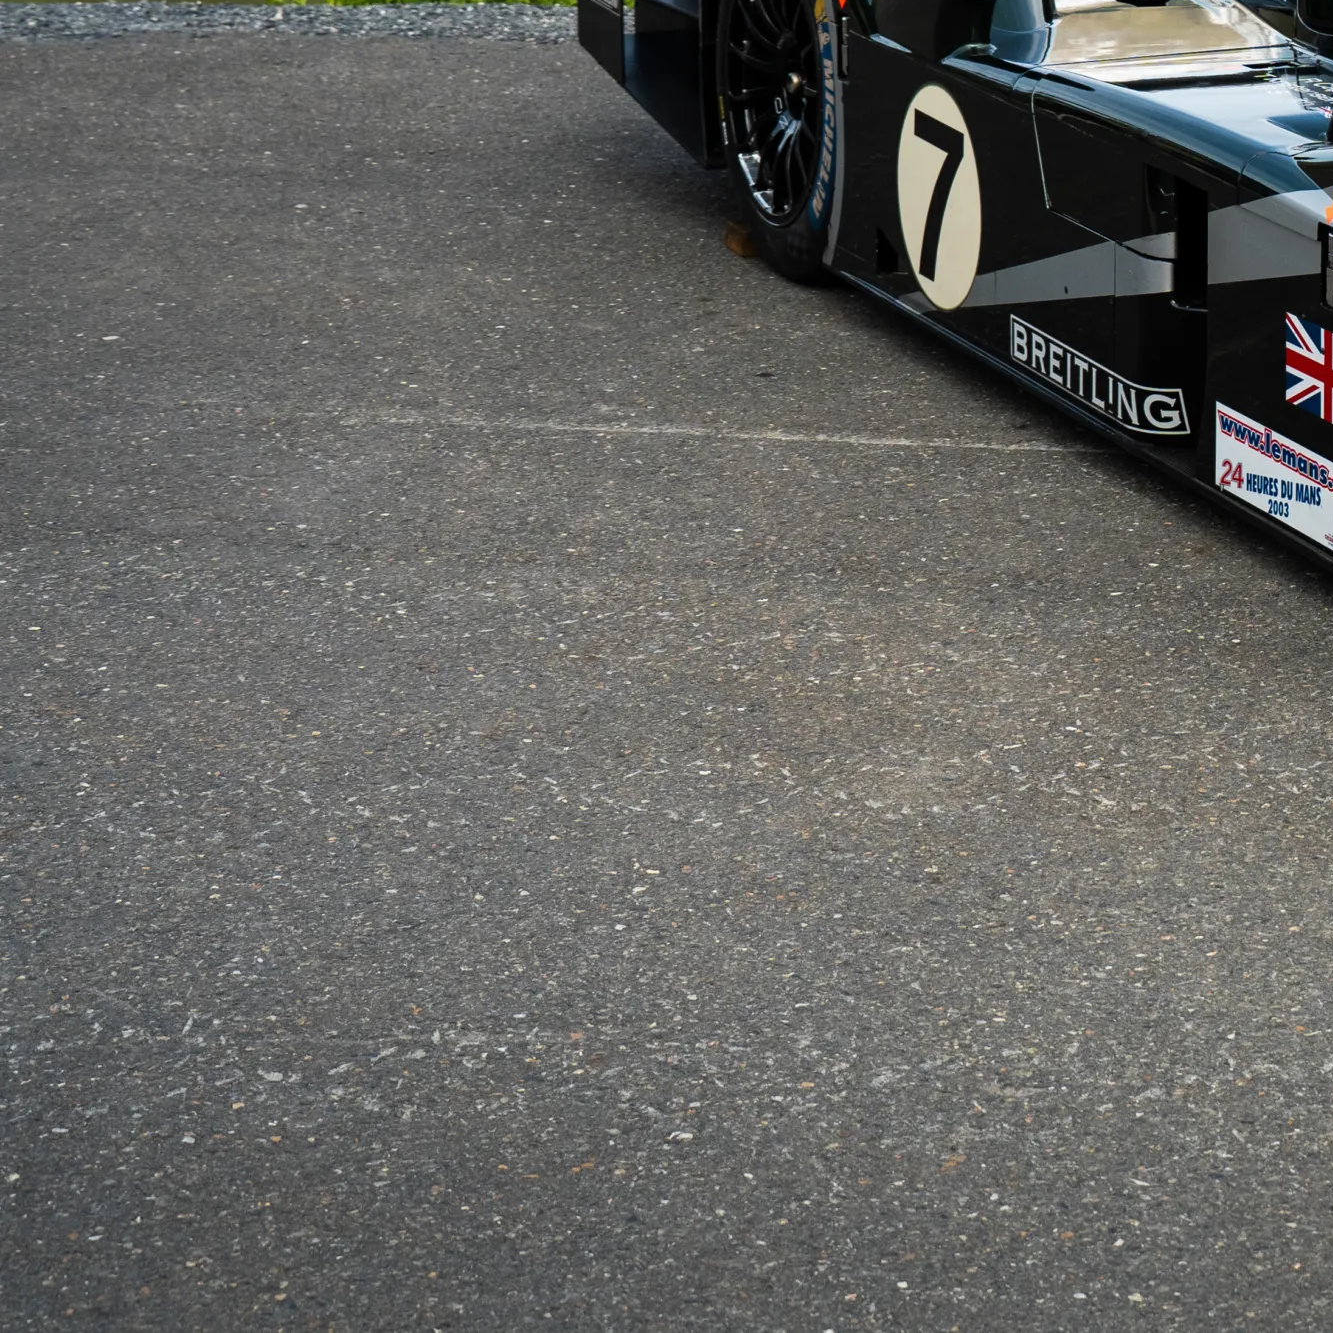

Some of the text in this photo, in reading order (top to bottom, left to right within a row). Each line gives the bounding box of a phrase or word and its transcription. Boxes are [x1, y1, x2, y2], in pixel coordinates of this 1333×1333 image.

[811, 57, 838, 219] MICHELIN
[913, 107, 965, 283] 7
[1012, 321, 1183, 430] BREITLING
[1220, 459, 1322, 507] 24 HEURES DU MANS
[1267, 499, 1290, 518] 2003
